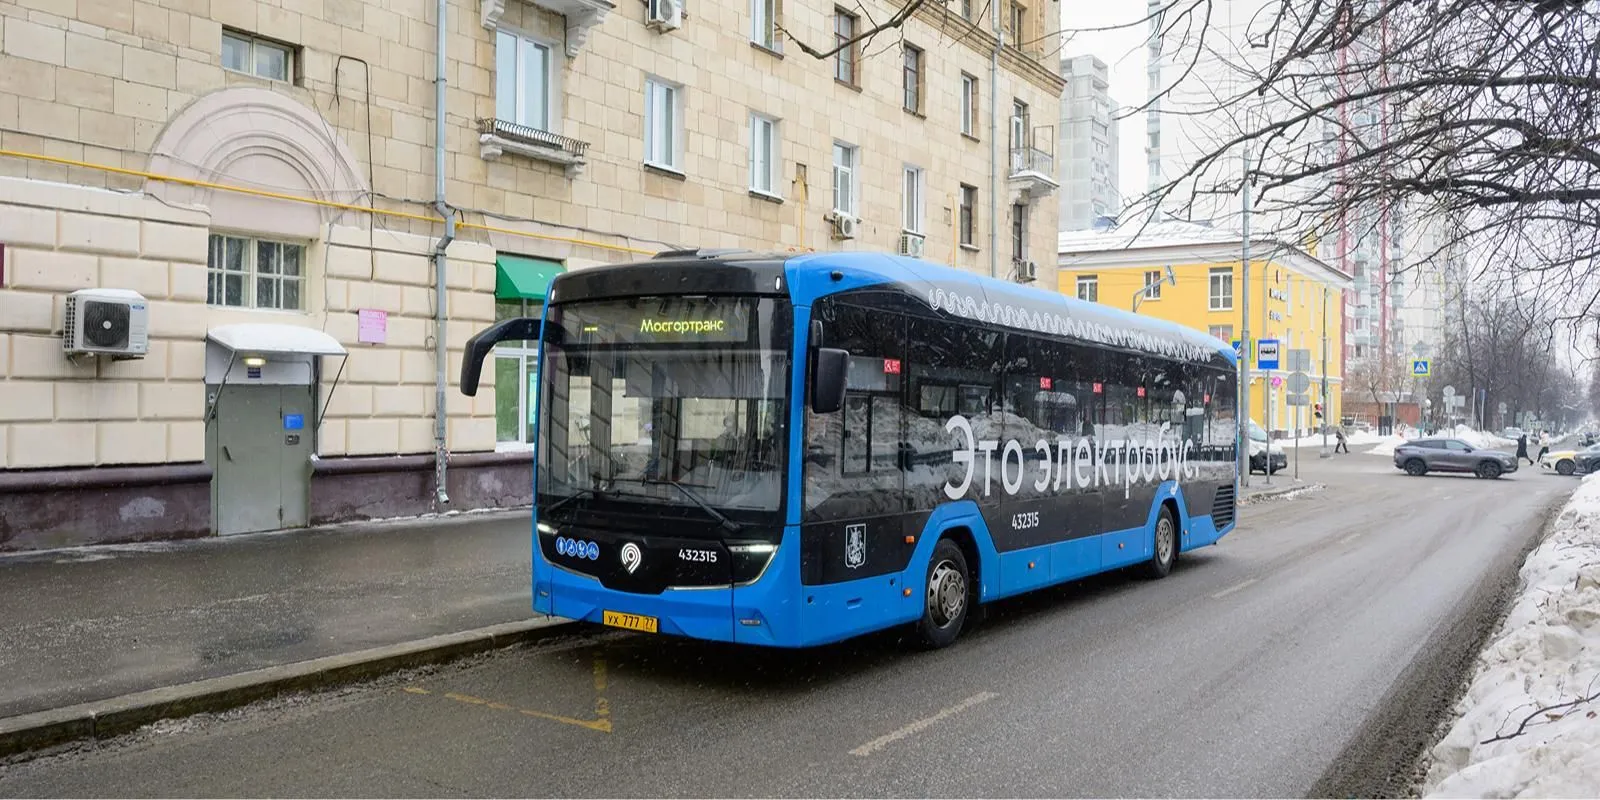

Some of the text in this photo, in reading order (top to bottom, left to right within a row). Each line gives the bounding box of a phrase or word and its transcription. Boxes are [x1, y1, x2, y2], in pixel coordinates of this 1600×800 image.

[640, 319, 724, 334] Мосгортранс
[943, 414, 1024, 500] Это
[1011, 511, 1040, 531] 432315
[678, 548, 718, 563] 432315
[622, 614, 640, 628] 777
